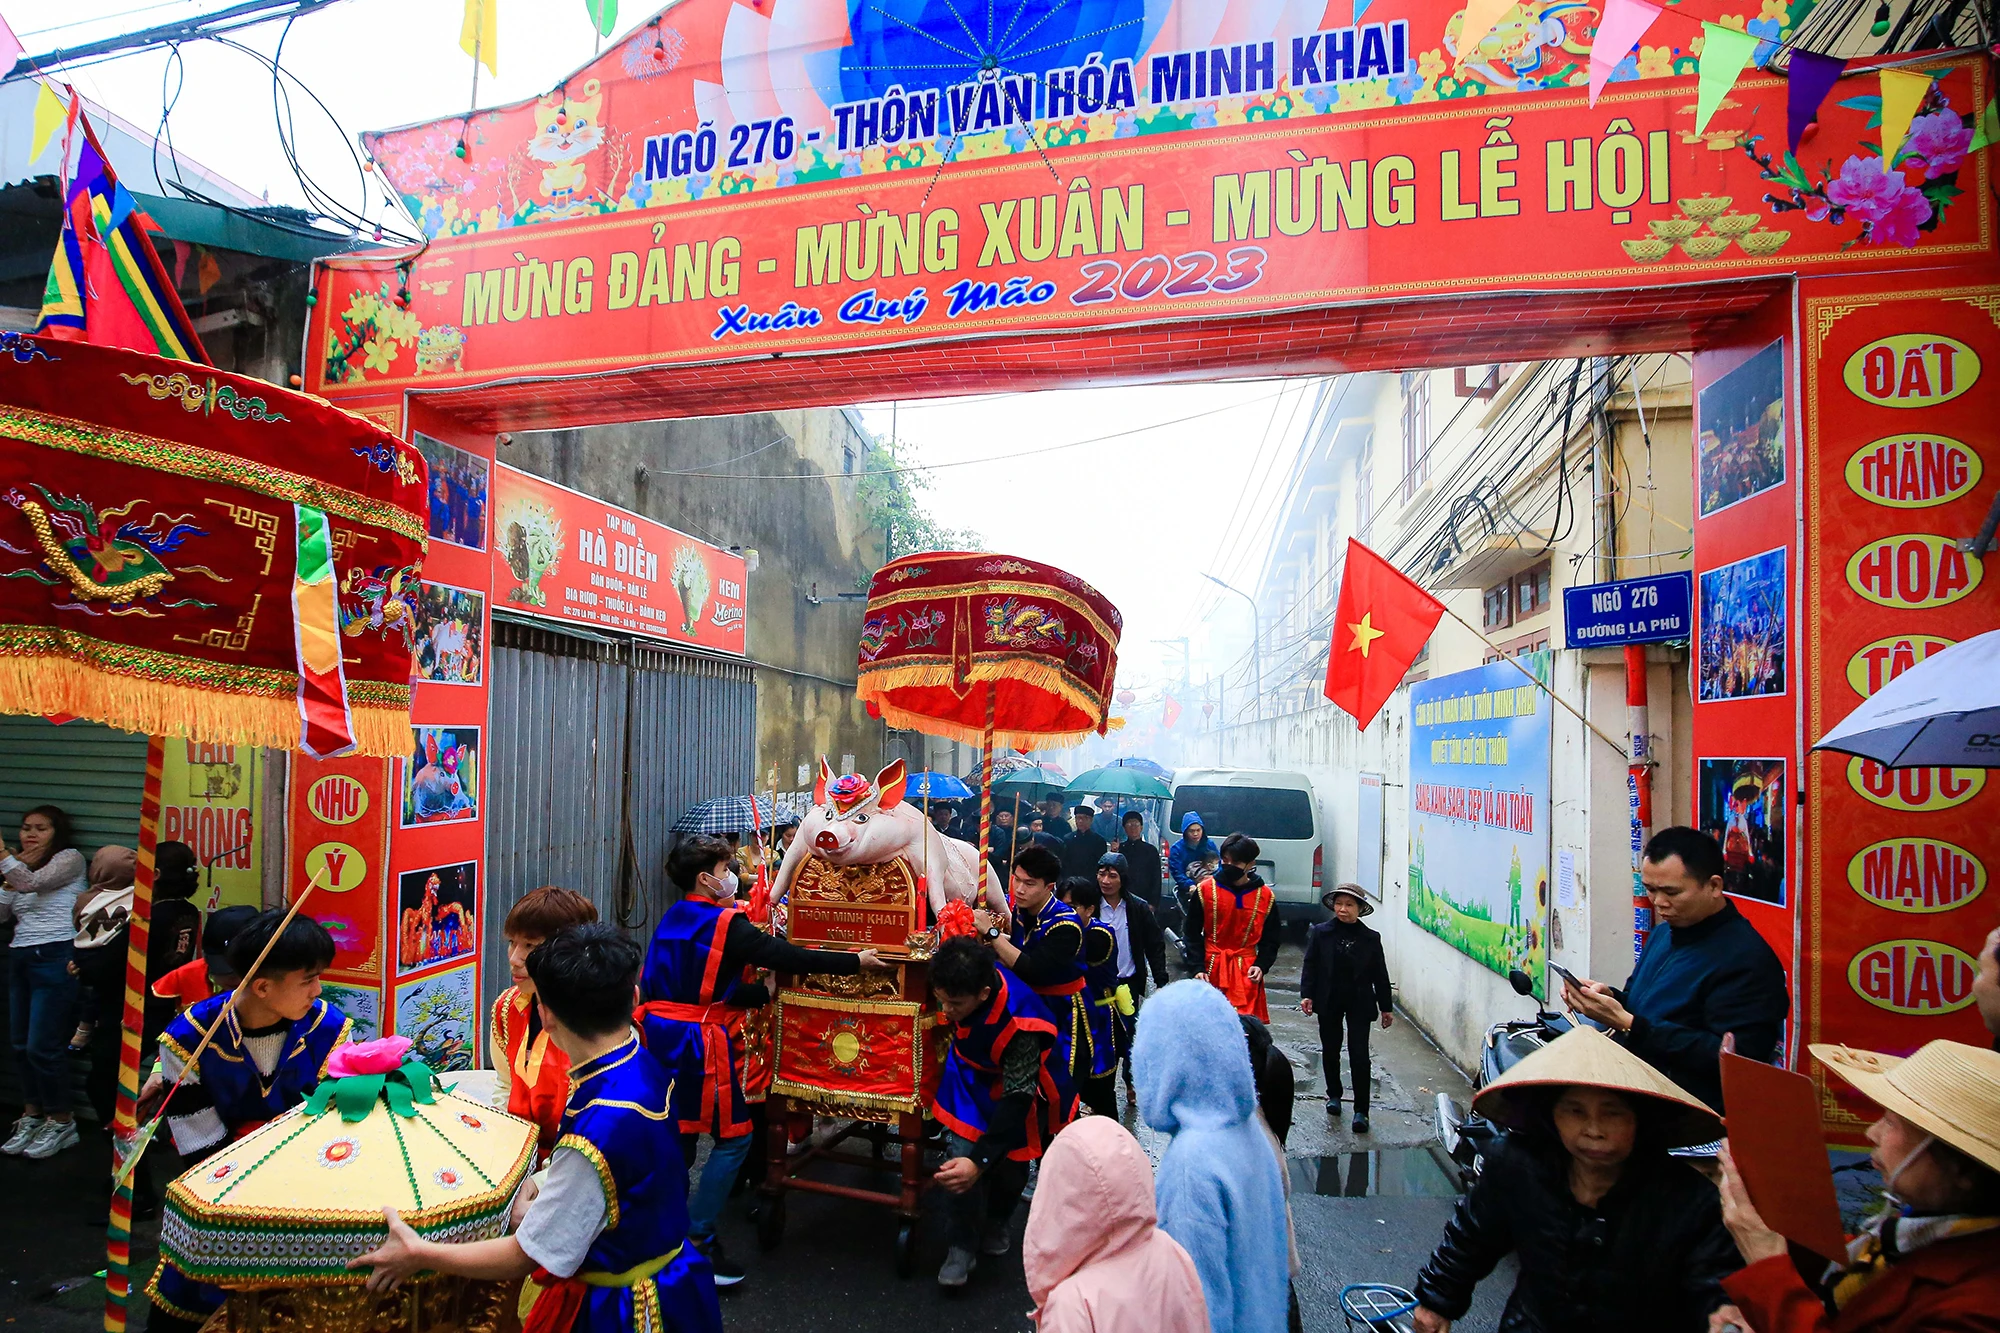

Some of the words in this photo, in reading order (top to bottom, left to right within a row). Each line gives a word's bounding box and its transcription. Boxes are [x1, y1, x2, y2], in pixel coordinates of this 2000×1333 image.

[643, 118, 718, 181] NGÕ
[728, 117, 795, 166] 276
[834, 88, 937, 150] THÔN
[1047, 54, 1135, 119] HÓA
[1152, 41, 1274, 104] MINH
[1292, 22, 1407, 87] KHAI
[462, 254, 593, 327] MỪNG
[607, 223, 742, 310] ĐẢNG
[795, 203, 959, 288] MỪNG
[978, 178, 1144, 267] XUÂN
[1211, 149, 1416, 244] MỪNG
[1442, 116, 1520, 220] LỄ
[1545, 118, 1671, 227] HỘI
[713, 303, 819, 338] Xuân
[839, 286, 927, 323] Quý
[947, 279, 1056, 317] Mão
[1071, 248, 1267, 305] 2023
[1863, 342, 1961, 398] ĐẤT
[1859, 440, 1970, 500] THĂNG
[606, 513, 620, 532] TẠP
[621, 519, 636, 537] HÓA
[579, 528, 607, 568] HÀ
[614, 536, 658, 582] ĐIỀN
[1858, 539, 1970, 603] HOA
[565, 587, 578, 602] BIA
[579, 590, 598, 607] RƯỢU
[604, 595, 625, 612] THUỐC
[626, 600, 634, 614] LÁ
[639, 604, 655, 619] BÁNH
[590, 572, 605, 588] BÁN
[627, 582, 640, 597] BÁN
[719, 578, 740, 600] KEM
[1592, 587, 1622, 613] NGÕ
[1631, 585, 1658, 609] 276
[713, 600, 743, 621] Merino
[1577, 622, 1625, 639] ĐƯỜNG
[1629, 620, 1647, 634] LA
[1651, 613, 1680, 631] PHÙ
[1861, 641, 1947, 696] TÂ
[1474, 687, 1493, 720] THÔN
[1494, 688, 1514, 718] MINH
[1515, 684, 1536, 717] KHAI
[1488, 730, 1508, 766] THÔN
[314, 777, 362, 822] NHƯ
[1468, 786, 1482, 831] ĐẸP
[1496, 790, 1508, 829] AN
[1509, 784, 1534, 835] TOÀN
[165, 791, 253, 869] PHÒNG
[325, 847, 347, 887] Ý
[1862, 843, 1976, 907] MẠNH
[799, 908, 830, 921] THÔN
[833, 911, 864, 924] MINH
[867, 913, 896, 926] KHAI
[827, 926, 855, 940] KÍNH
[1858, 945, 1975, 1009] GIÀU
